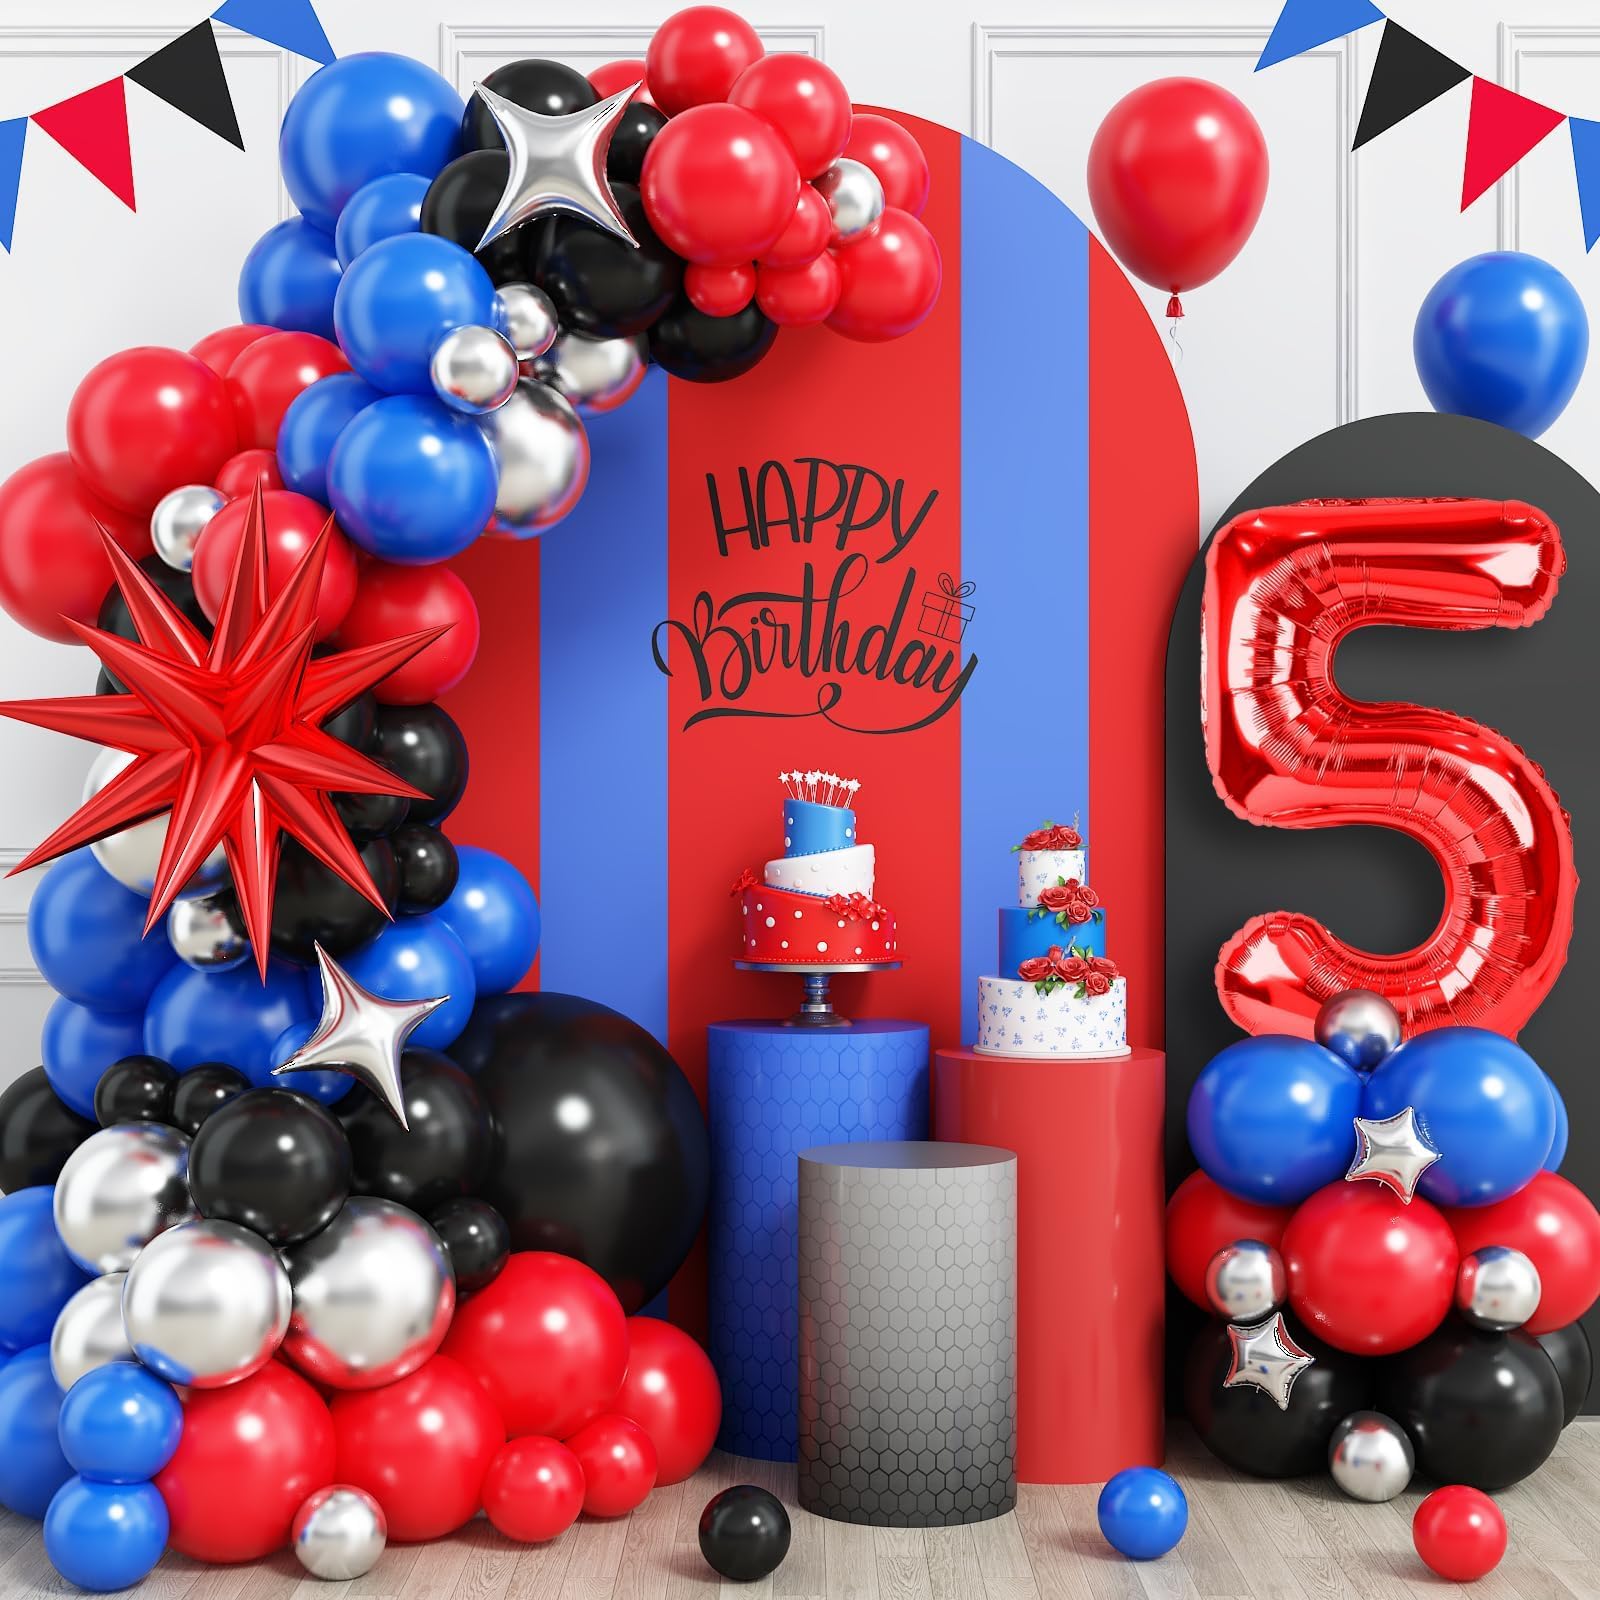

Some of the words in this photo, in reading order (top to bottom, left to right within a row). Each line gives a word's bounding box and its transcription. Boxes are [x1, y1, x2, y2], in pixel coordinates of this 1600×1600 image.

[706, 457, 939, 564] HAPPY
[652, 553, 978, 734] Birthday
[1201, 497, 1579, 1042] 5
